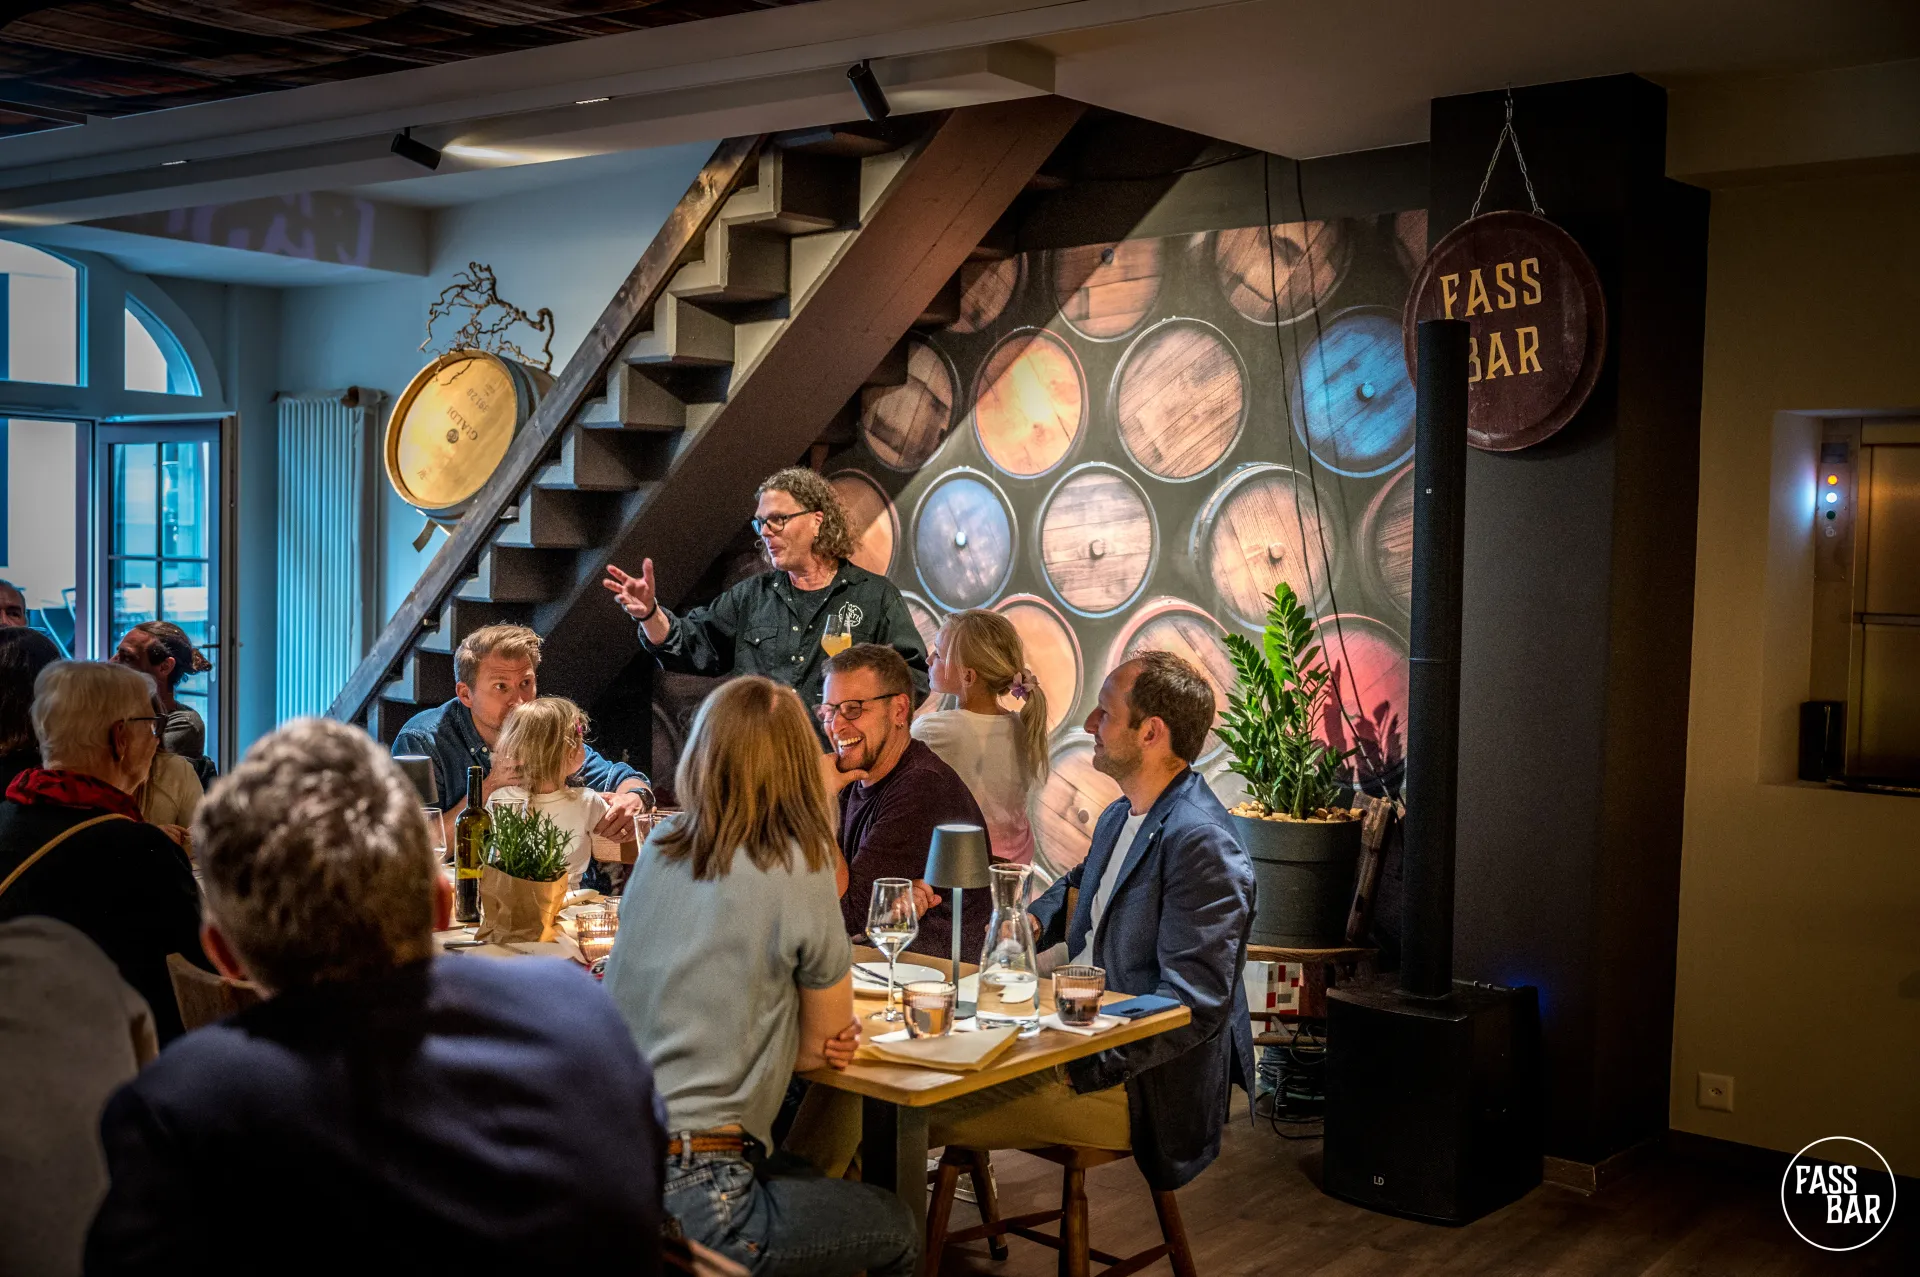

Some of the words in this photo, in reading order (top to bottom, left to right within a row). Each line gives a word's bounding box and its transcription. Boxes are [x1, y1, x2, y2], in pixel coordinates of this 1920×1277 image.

[1440, 257, 1542, 320] FASS
[446, 406, 478, 441] GIALDI
[1373, 1175, 1385, 1186] LD
